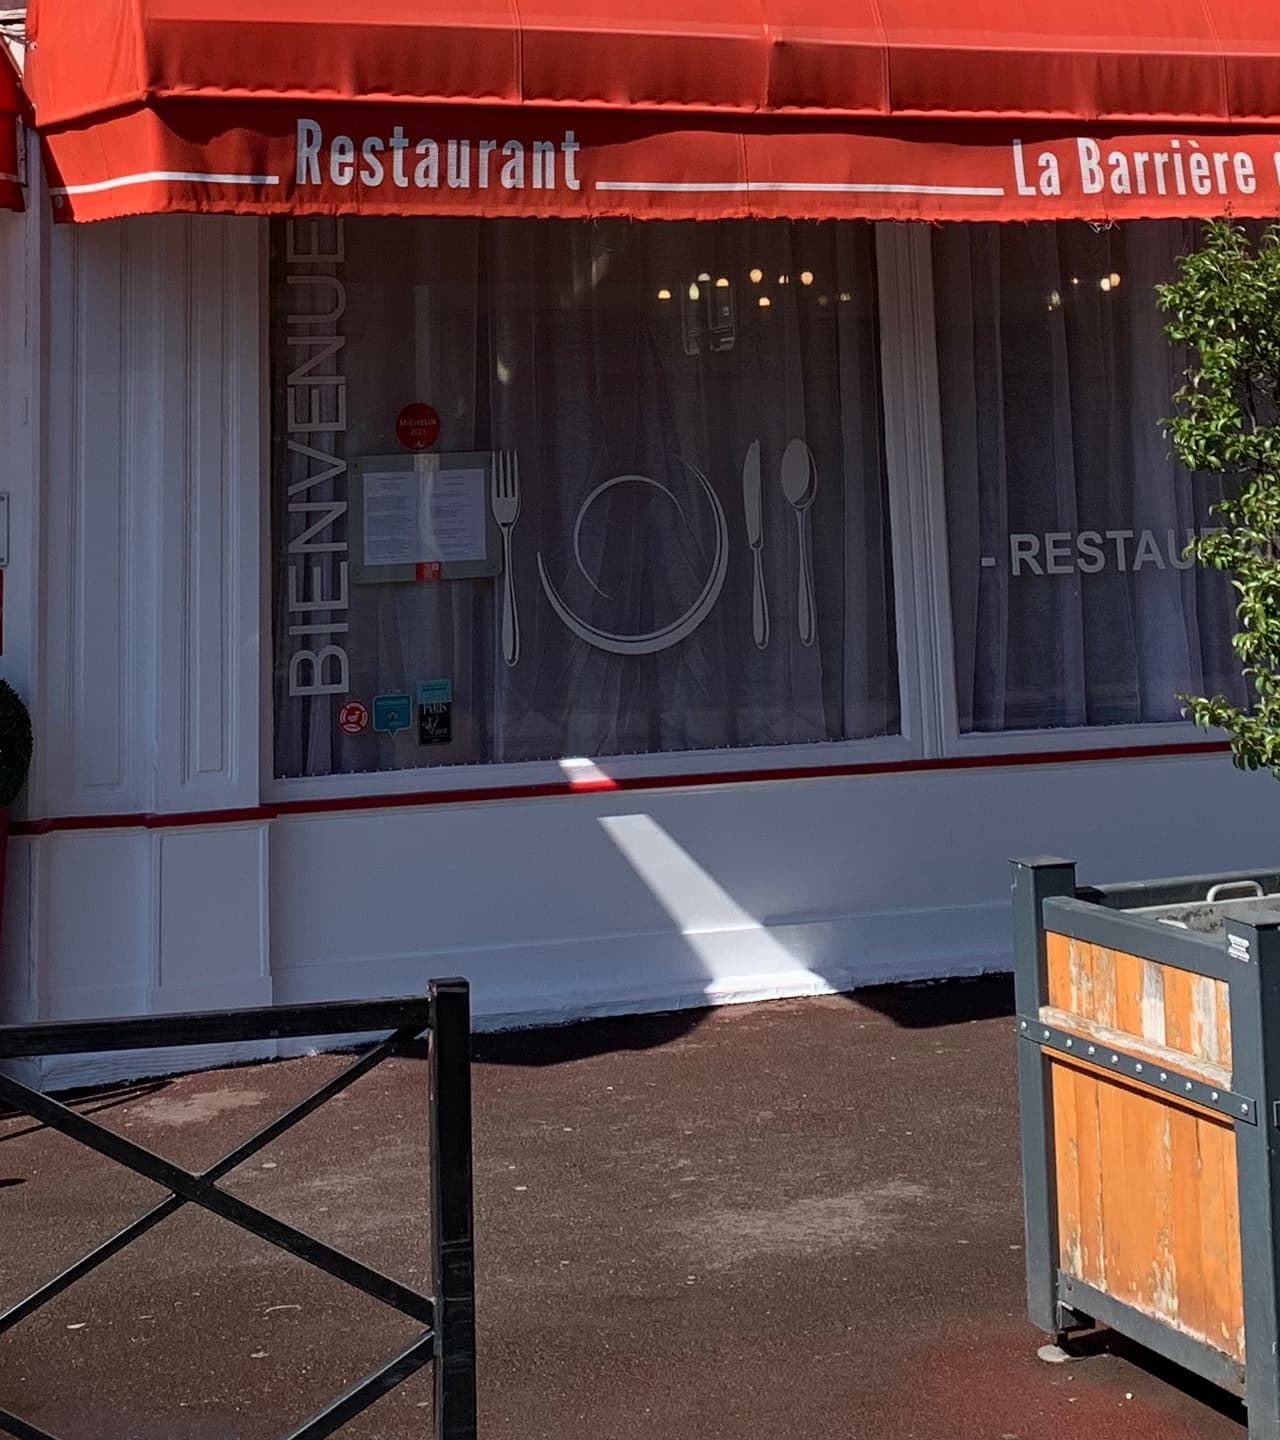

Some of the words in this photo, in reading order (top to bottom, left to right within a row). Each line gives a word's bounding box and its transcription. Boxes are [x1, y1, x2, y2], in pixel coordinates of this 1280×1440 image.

[295, 118, 581, 191] Restaurant
[1013, 138, 1061, 196] La
[1077, 137, 1257, 195] Barrière
[287, 216, 350, 697] BIENVENUE
